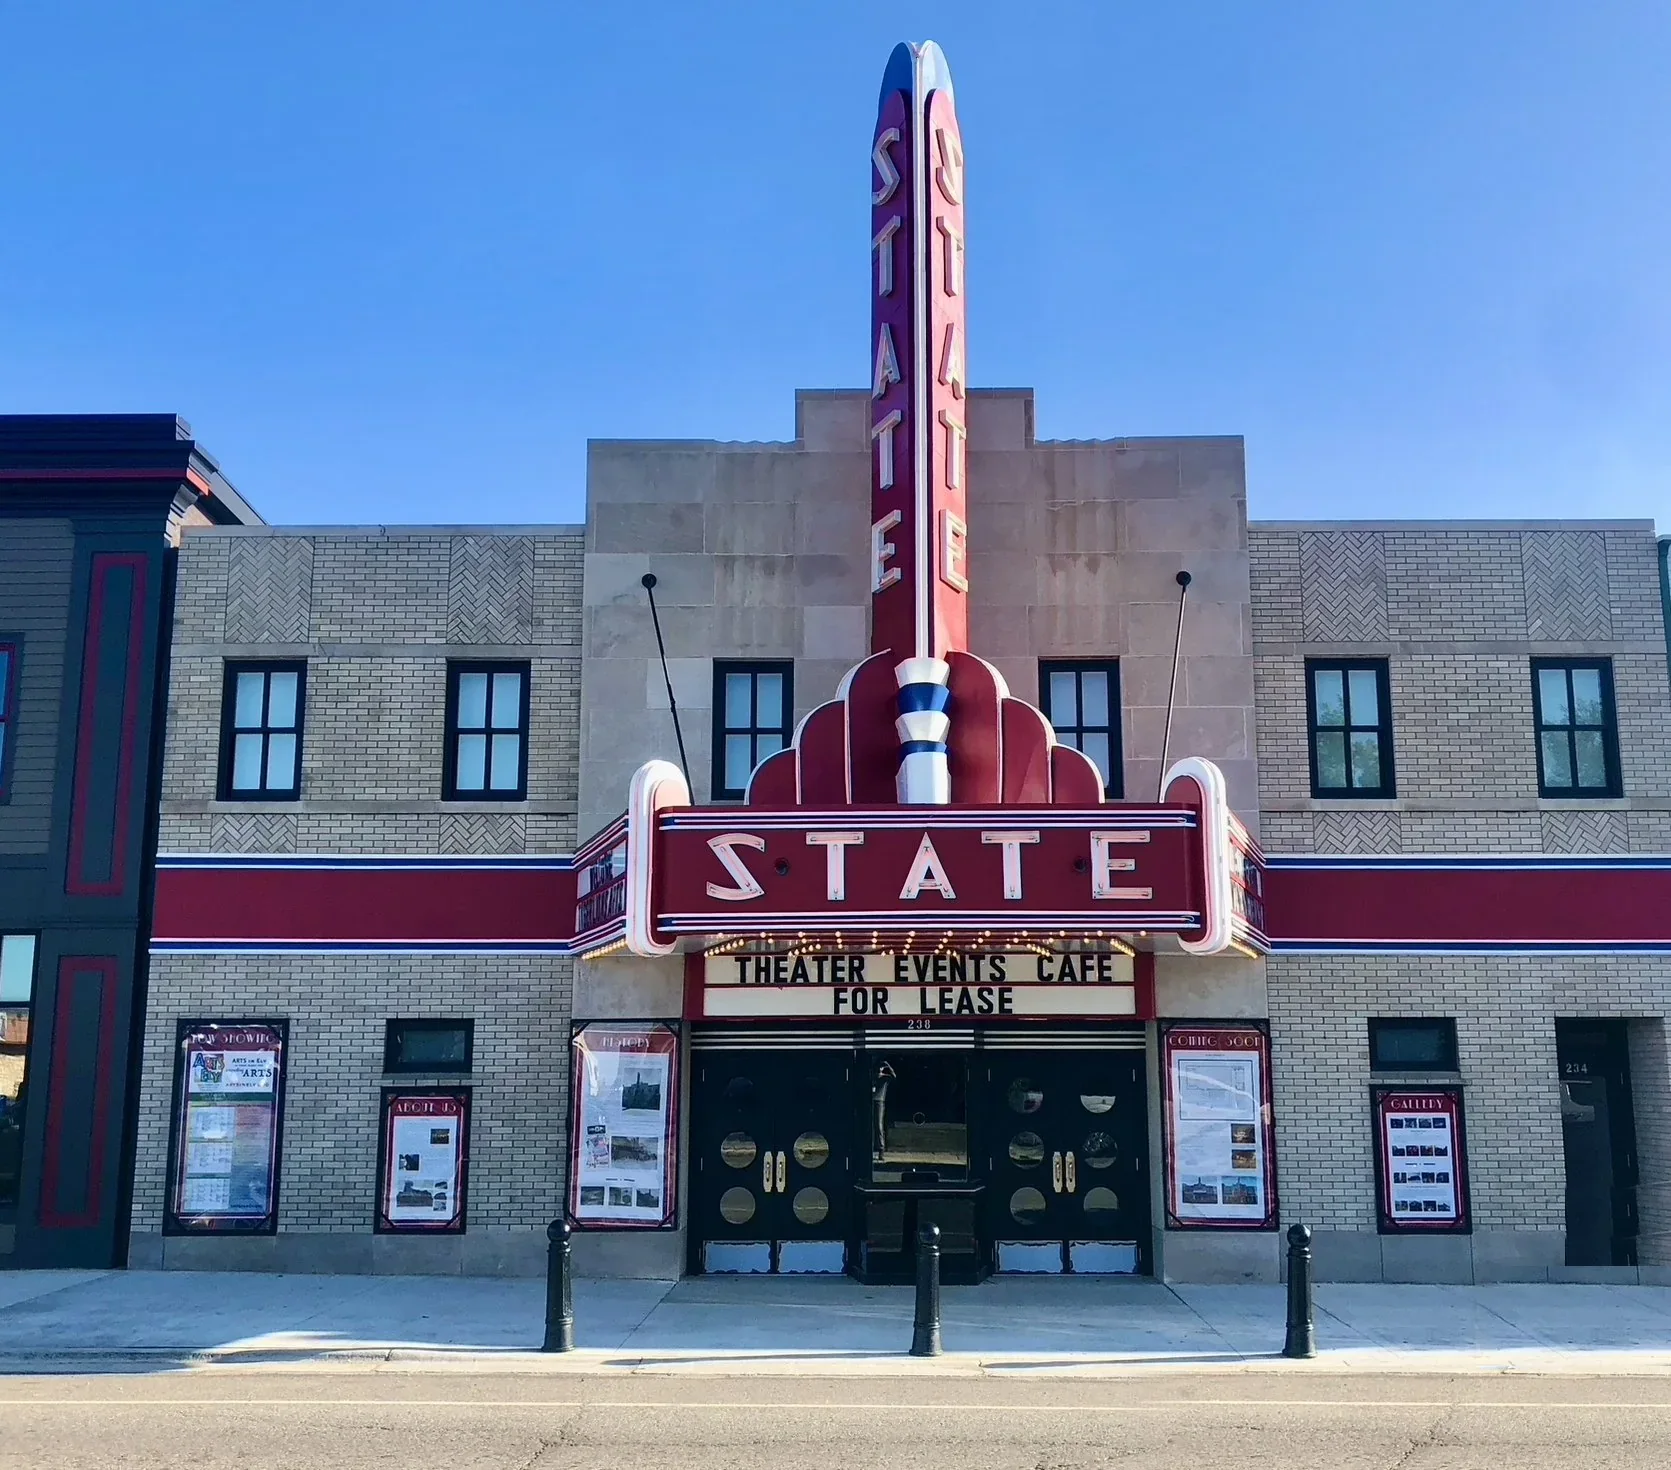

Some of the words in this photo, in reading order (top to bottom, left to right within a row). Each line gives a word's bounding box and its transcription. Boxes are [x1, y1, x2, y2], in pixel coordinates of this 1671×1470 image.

[872, 127, 902, 593] STATE
[935, 128, 968, 593] STATE
[706, 830, 1153, 901] STATE
[735, 954, 865, 983] THEATER
[894, 954, 1006, 983] EVENTS
[1037, 953, 1112, 982] CAFE
[833, 987, 889, 1015] FOR
[920, 987, 1013, 1015] LEASE
[907, 1019, 931, 1030] 238
[602, 1036, 650, 1048] HISTORY
[1169, 1035, 1218, 1047] COMING
[1225, 1035, 1260, 1047] SOON
[242, 1068, 273, 1078] ARTS
[1565, 1062, 1588, 1074] 234
[396, 1102, 434, 1113] ABOUT
[441, 1102, 457, 1113] US
[1391, 1098, 1444, 1110] GALLERY
